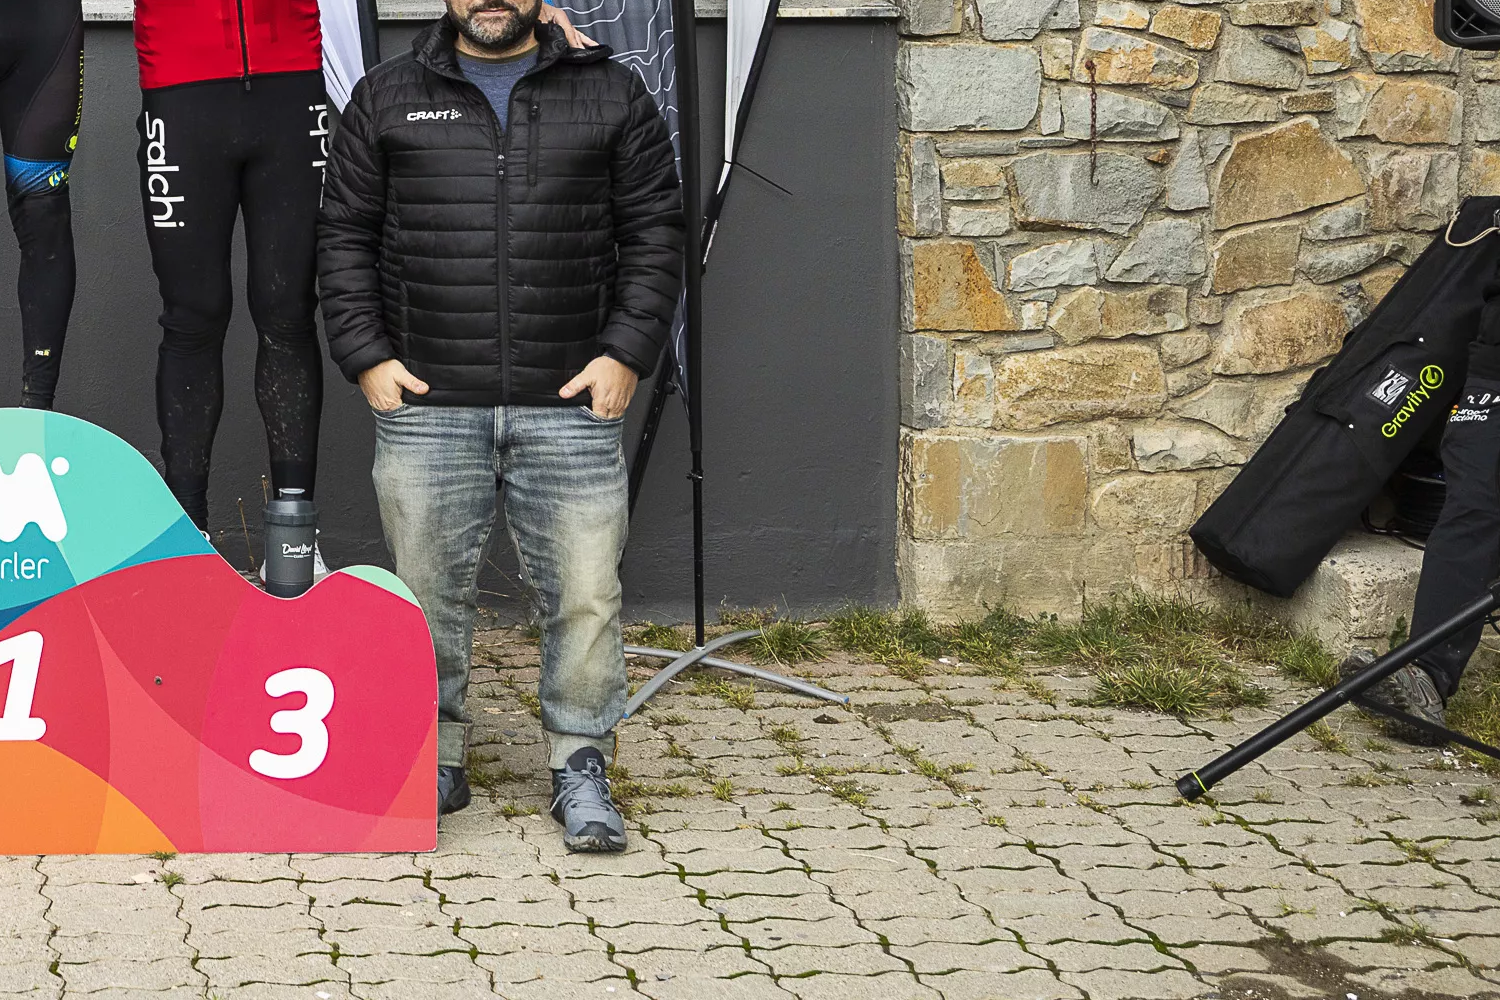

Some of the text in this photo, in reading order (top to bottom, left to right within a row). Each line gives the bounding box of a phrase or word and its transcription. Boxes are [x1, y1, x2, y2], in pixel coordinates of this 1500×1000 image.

[406, 109, 450, 121] CRAFT
[1381, 385, 1431, 438] Gravity
[248, 667, 336, 780] 3
